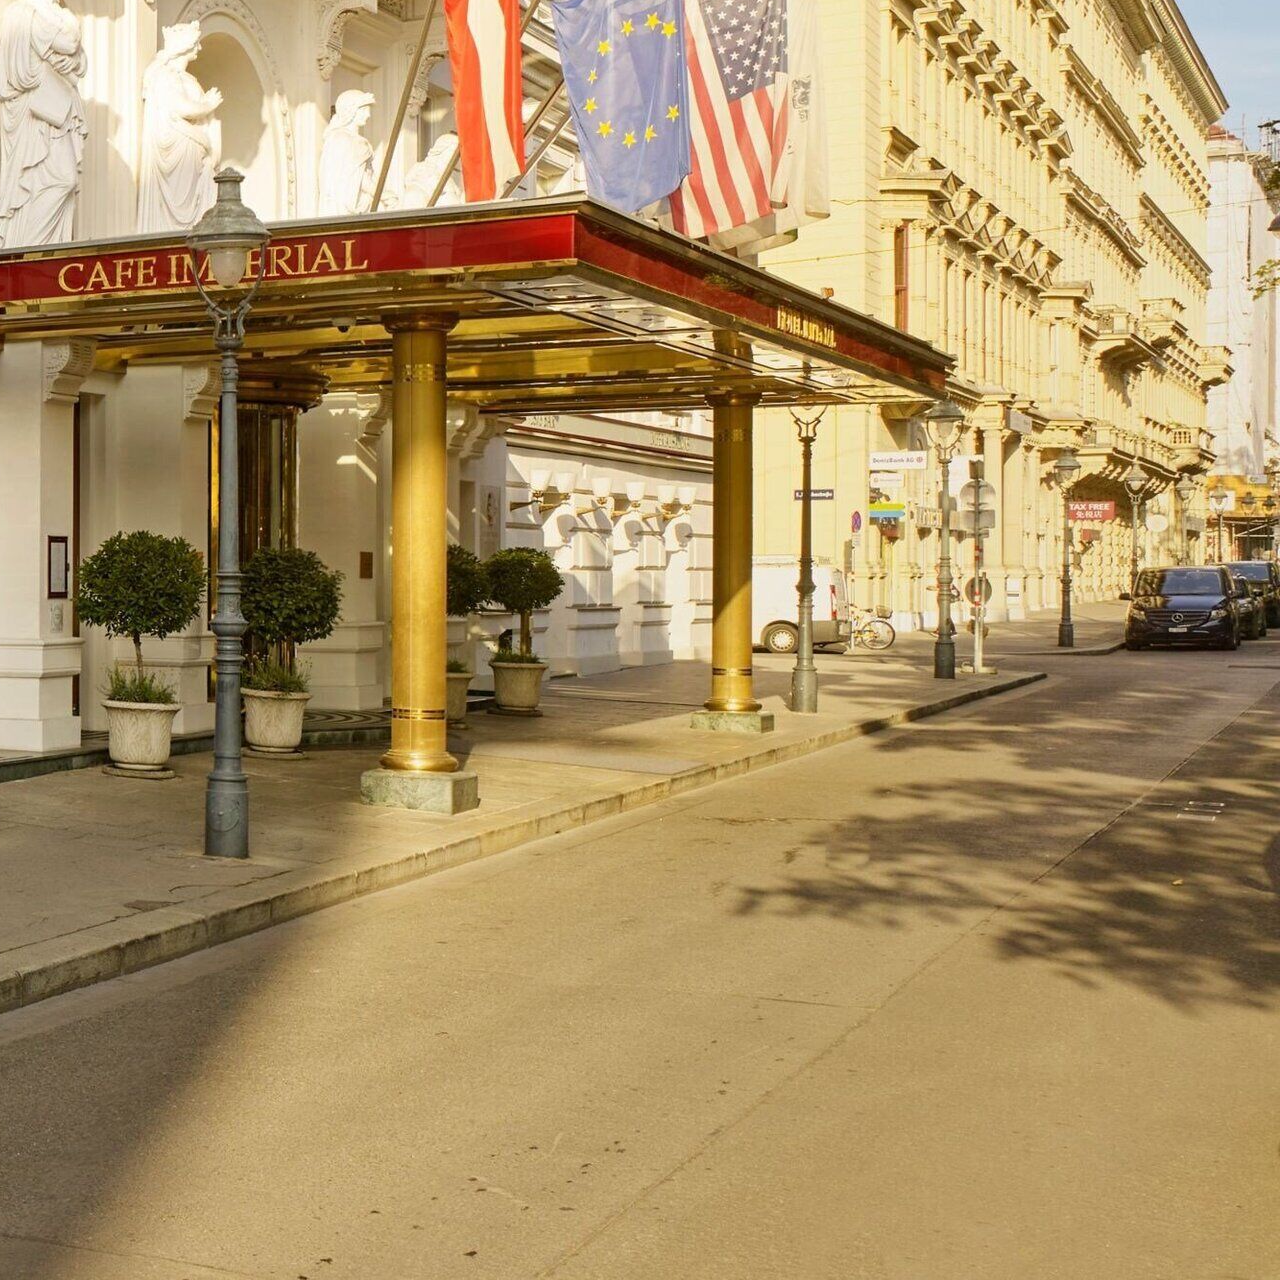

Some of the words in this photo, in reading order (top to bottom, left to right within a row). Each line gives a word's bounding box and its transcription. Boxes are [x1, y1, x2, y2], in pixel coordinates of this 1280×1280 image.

[57, 256, 157, 293] CAFE
[167, 239, 369, 286] IMERIAL
[1069, 503, 1087, 511] TAX
[1088, 503, 1110, 511] FREE
